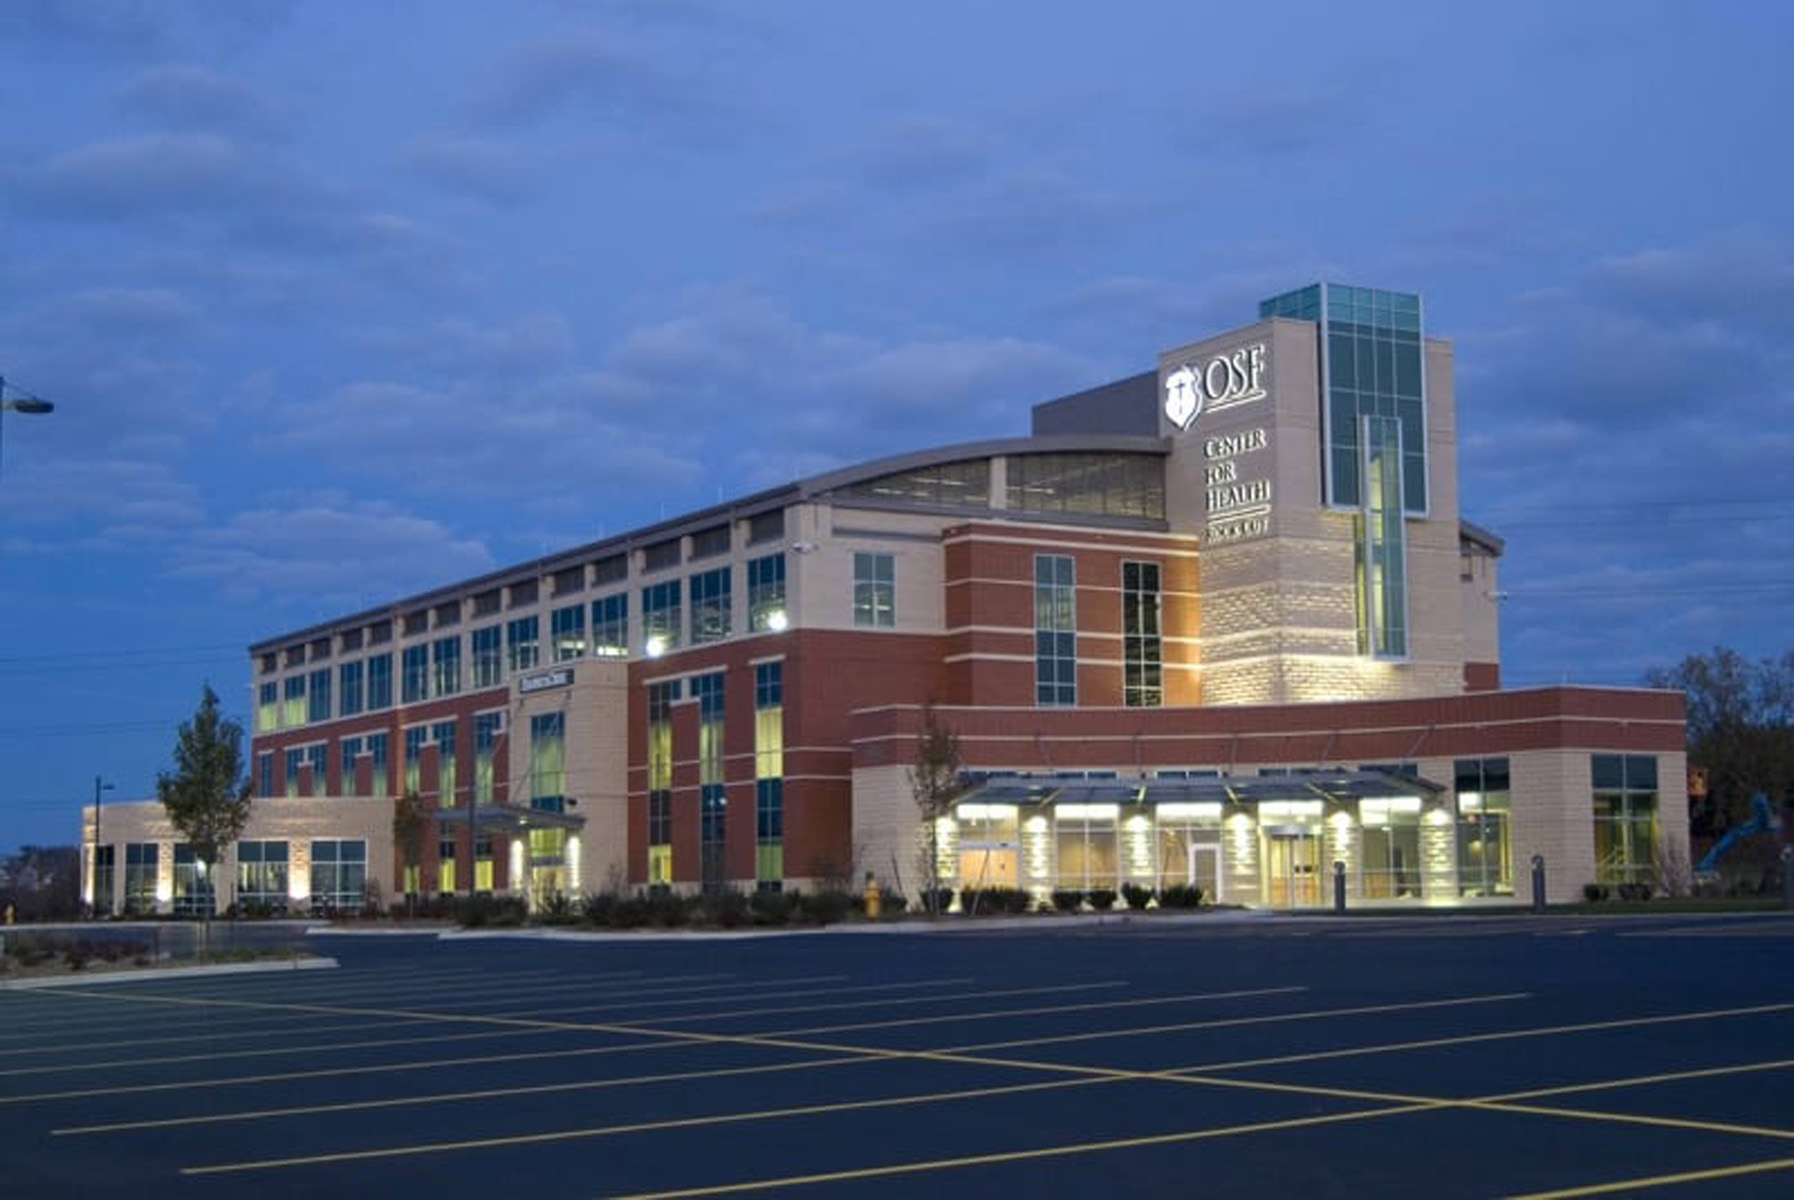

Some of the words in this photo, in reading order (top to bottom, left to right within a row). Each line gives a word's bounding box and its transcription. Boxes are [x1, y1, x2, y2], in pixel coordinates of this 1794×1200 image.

[1205, 344, 1265, 401] OSF
[1204, 428, 1267, 460] CENTER
[1204, 460, 1236, 487] FOR
[1205, 480, 1270, 512] HEALTH
